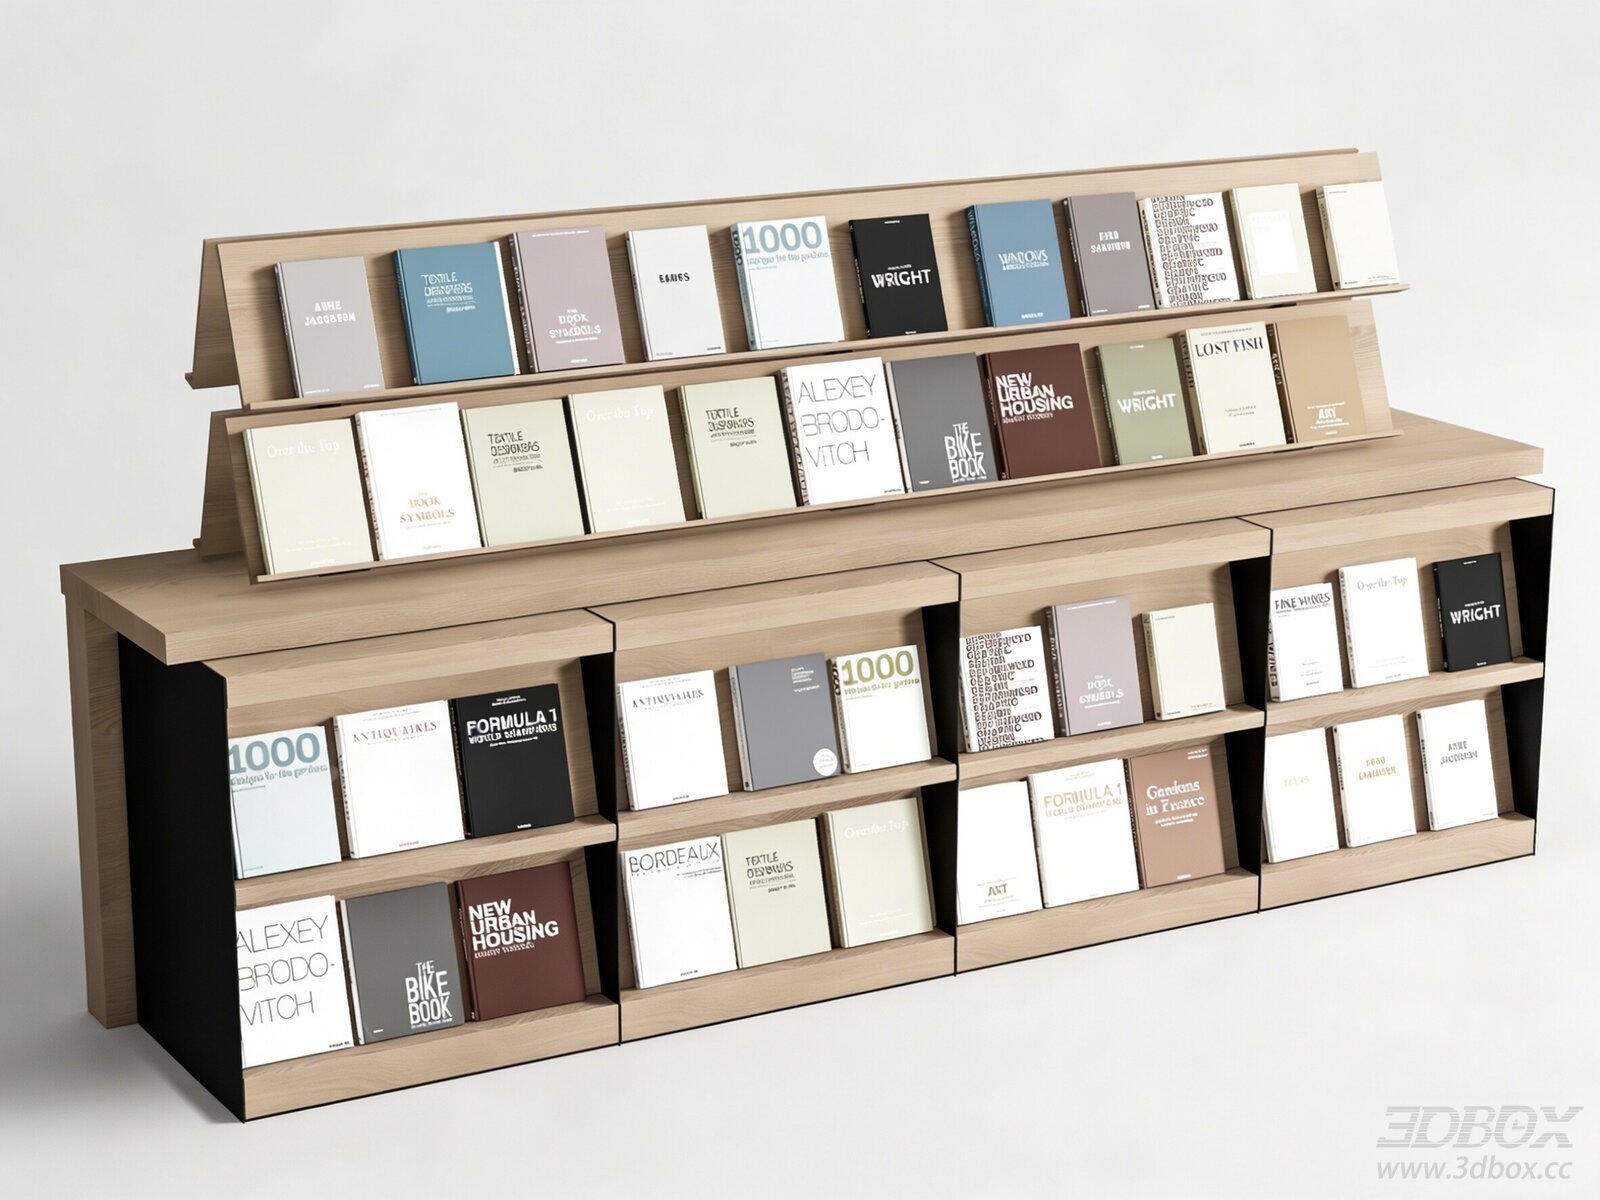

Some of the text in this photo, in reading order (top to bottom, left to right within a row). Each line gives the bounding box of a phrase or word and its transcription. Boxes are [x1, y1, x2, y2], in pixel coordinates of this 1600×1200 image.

[742, 221, 822, 254] 1000
[871, 268, 932, 288] WRIGHT
[1194, 336, 1264, 357] LOST FISH
[798, 374, 876, 403] ALEXEY
[995, 372, 1032, 390] NEW
[997, 384, 1055, 402] URBAN
[1000, 395, 1074, 418] HOUSING
[1117, 393, 1176, 414] WRIGHT
[801, 407, 885, 436] BRODO-
[805, 441, 870, 468] VITCH
[944, 433, 984, 460] BIKE
[949, 453, 986, 478] BOOK
[1450, 604, 1501, 625] WRIGHT
[841, 650, 914, 686] 1000
[467, 712, 546, 735] FORMULA
[549, 708, 557, 723] 1
[228, 732, 320, 775] 1000
[629, 842, 720, 874] BORDEAUX
[468, 898, 511, 921] NEW
[471, 910, 536, 935] URBAN
[236, 915, 328, 953] ALEXEY
[472, 921, 559, 951] HOUSING
[238, 952, 335, 992] BRODO-
[416, 960, 434, 975] THE
[405, 970, 450, 1003] BIKE
[408, 996, 452, 1024] BOOK
